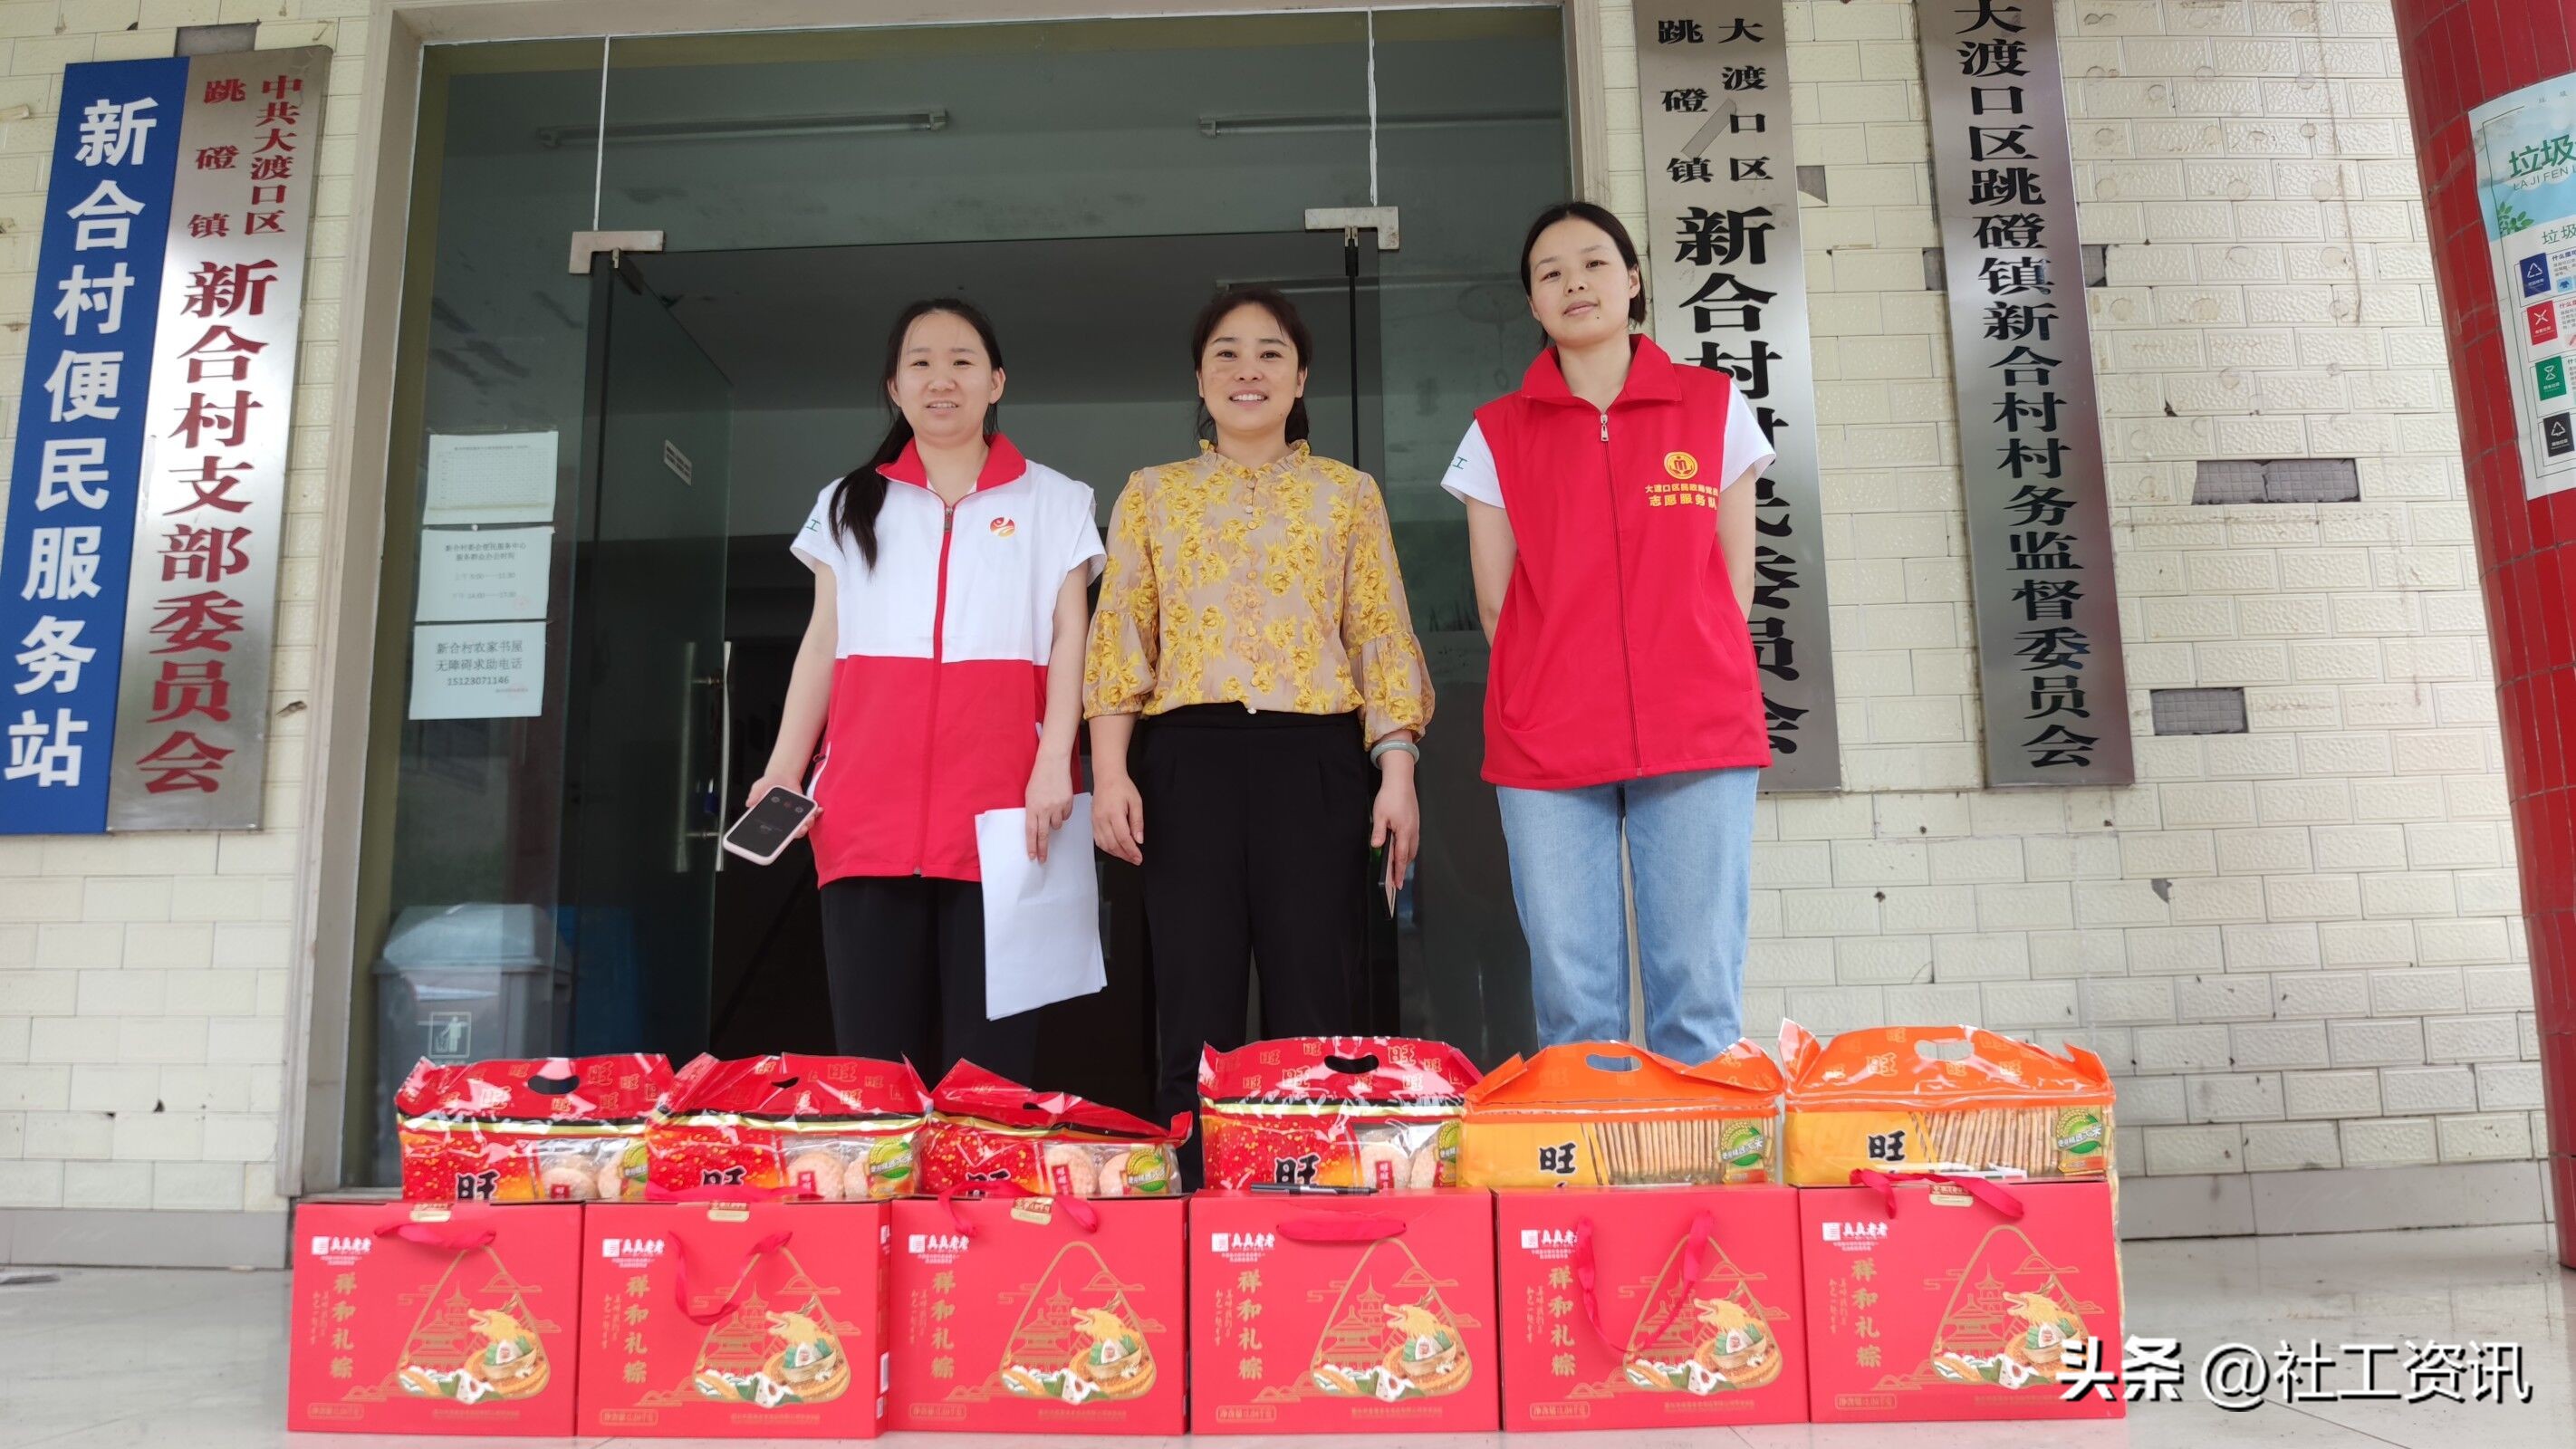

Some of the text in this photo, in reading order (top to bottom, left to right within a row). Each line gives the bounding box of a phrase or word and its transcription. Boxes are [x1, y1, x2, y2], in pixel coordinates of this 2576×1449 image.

[187, 78, 247, 240] 跳磴镇
[244, 74, 303, 236] 中共大渡口区
[1658, 19, 1714, 184] 跳磴镇
[1717, 18, 1773, 181] 大渡口区
[4, 97, 159, 788] 新合村便民服务站
[1956, 0, 2100, 769] 大渡口区跳磴镇新合村村务监督委员会
[136, 259, 278, 794] 新合村支部委员会
[1274, 1155, 1322, 1185] 旺
[1539, 1143, 1577, 1175] 旺
[1868, 1130, 1907, 1162] 旺
[1236, 1268, 1264, 1380] 祥和礼粽
[1547, 1265, 1577, 1377] 祥和礼粽
